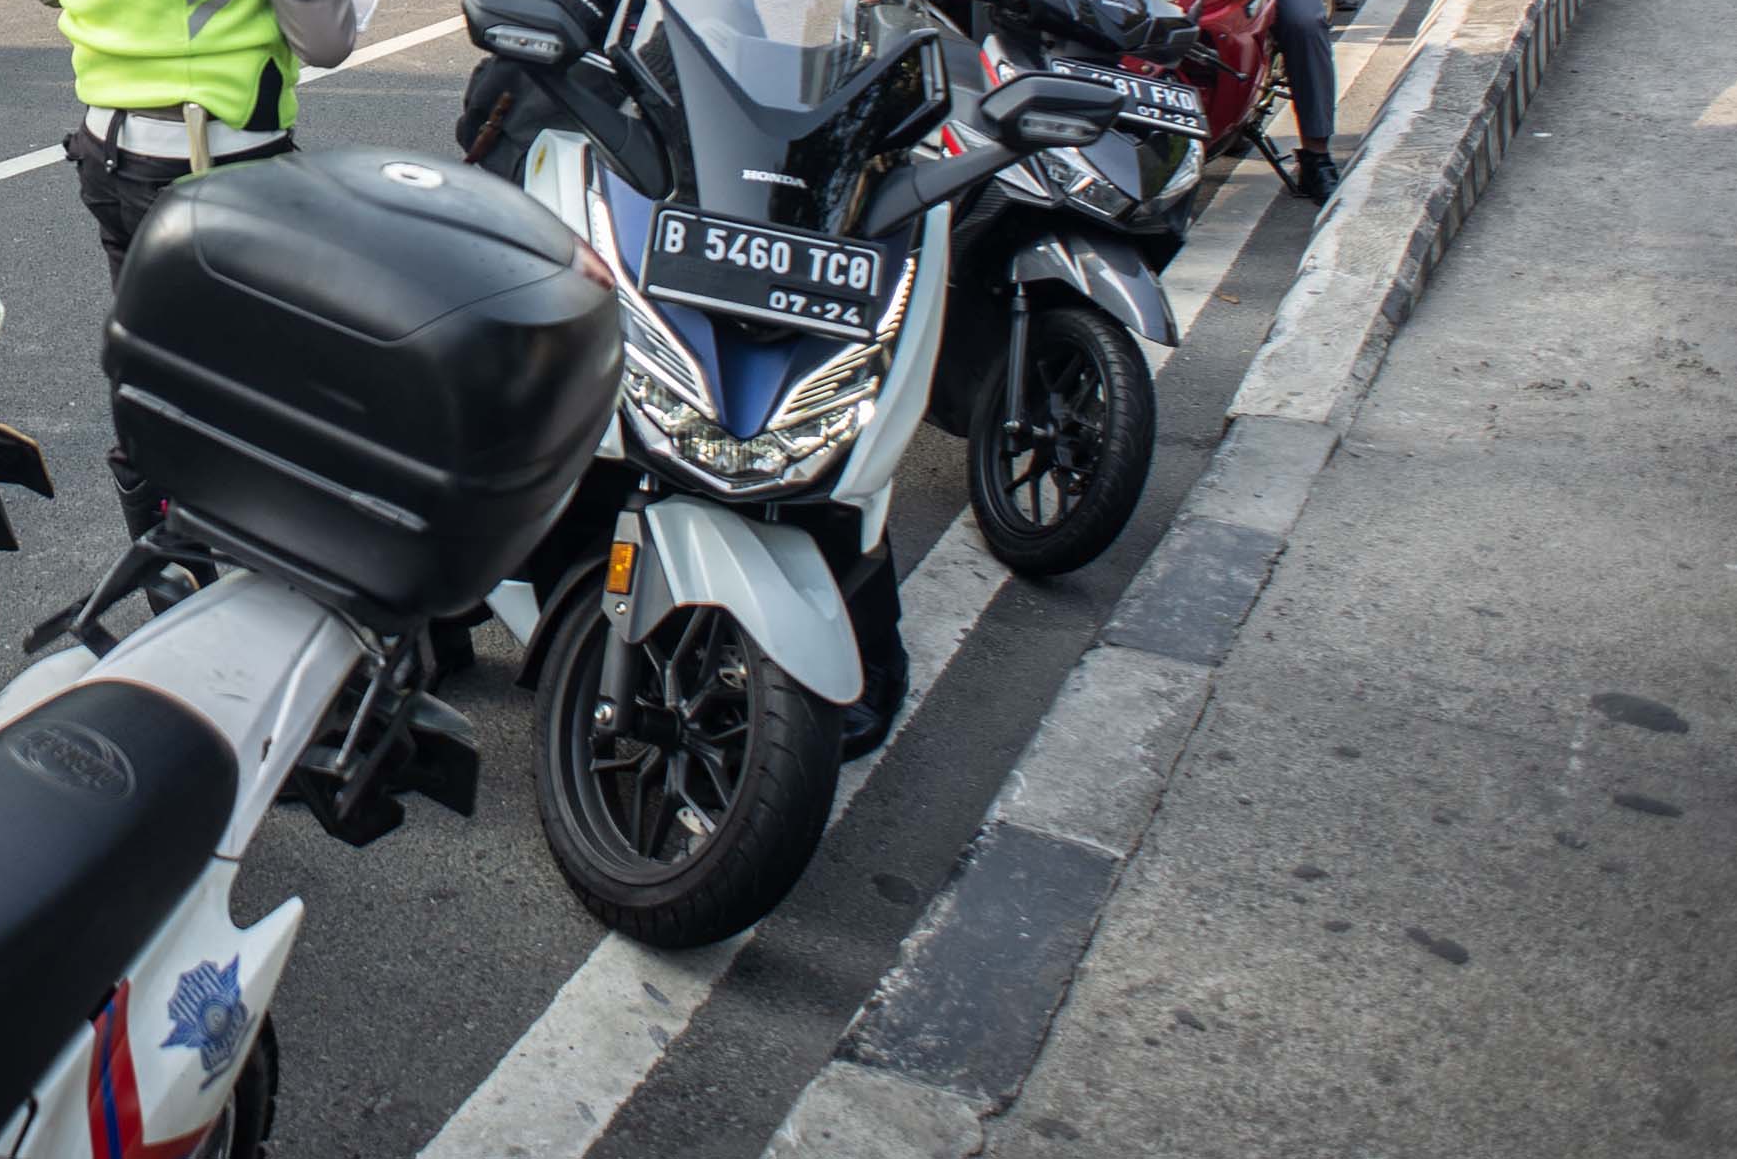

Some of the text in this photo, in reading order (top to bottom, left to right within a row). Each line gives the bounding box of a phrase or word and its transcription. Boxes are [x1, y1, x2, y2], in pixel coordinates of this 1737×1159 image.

[743, 169, 807, 189] HONDA
[664, 220, 686, 253] B
[705, 228, 791, 274] 5460
